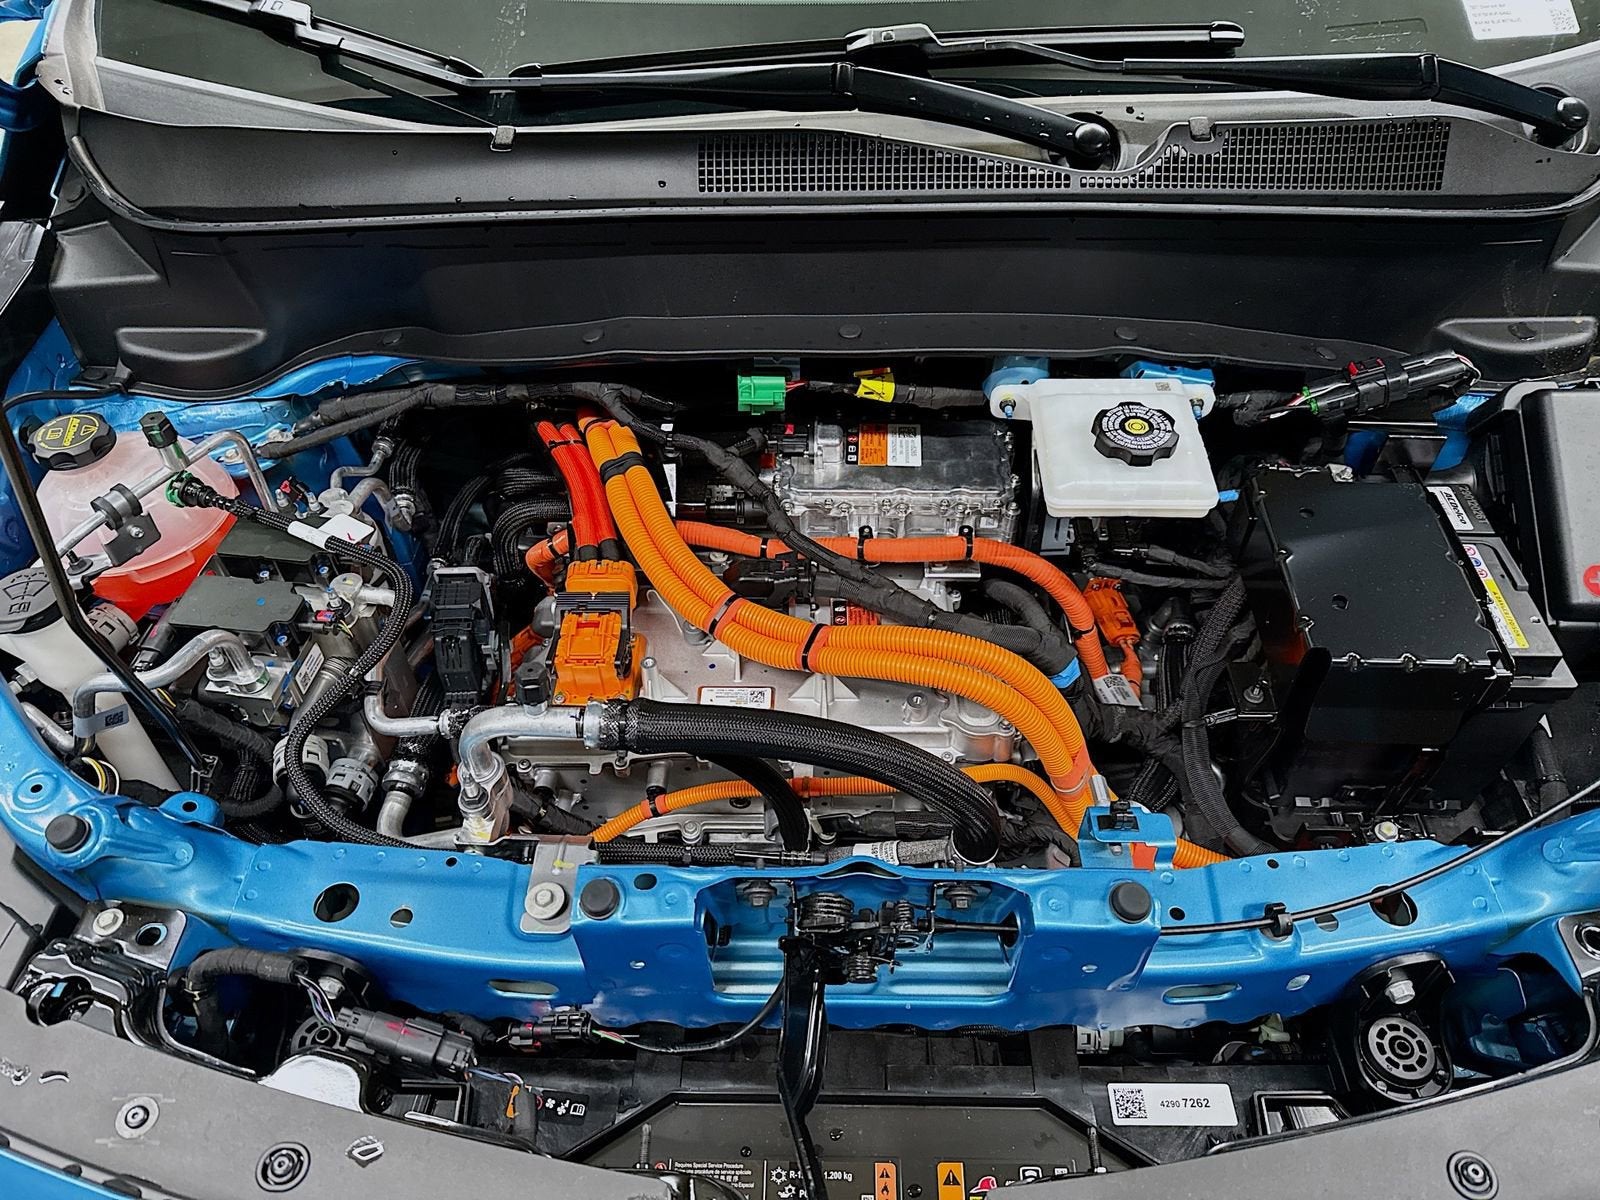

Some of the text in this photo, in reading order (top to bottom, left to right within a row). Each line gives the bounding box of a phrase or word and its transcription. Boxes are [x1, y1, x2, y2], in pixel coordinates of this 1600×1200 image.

[1443, 491, 1467, 524] ACDelco
[1182, 1098, 1211, 1108] 7262
[824, 1171, 842, 1180] 1.200
[843, 1171, 853, 1182] kg
